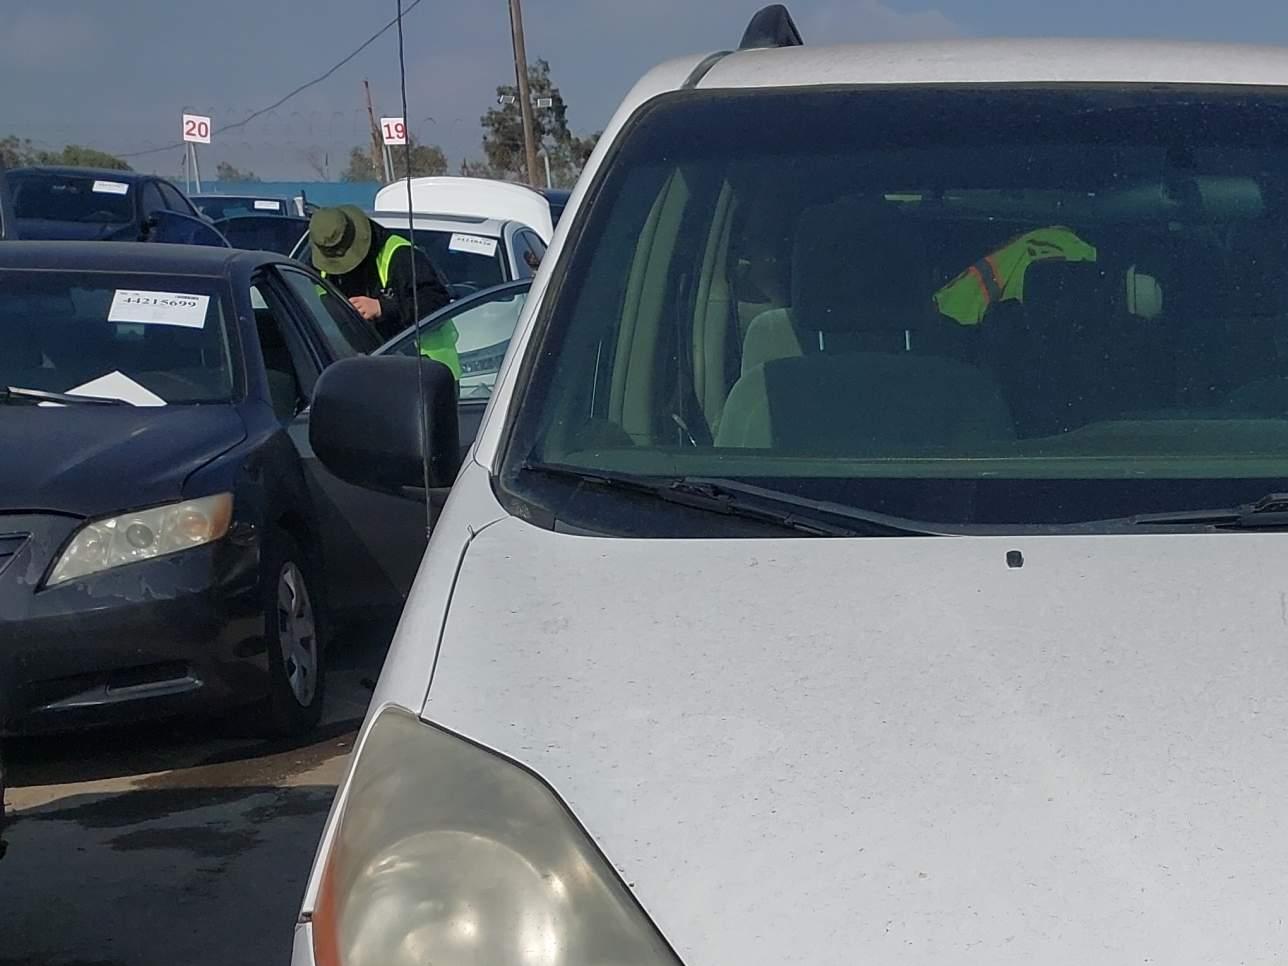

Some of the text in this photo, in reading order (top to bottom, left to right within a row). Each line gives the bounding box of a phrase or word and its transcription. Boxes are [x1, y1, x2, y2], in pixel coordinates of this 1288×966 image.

[185, 120, 208, 138] 20
[384, 123, 405, 139] 19
[123, 297, 197, 308] 44215699
